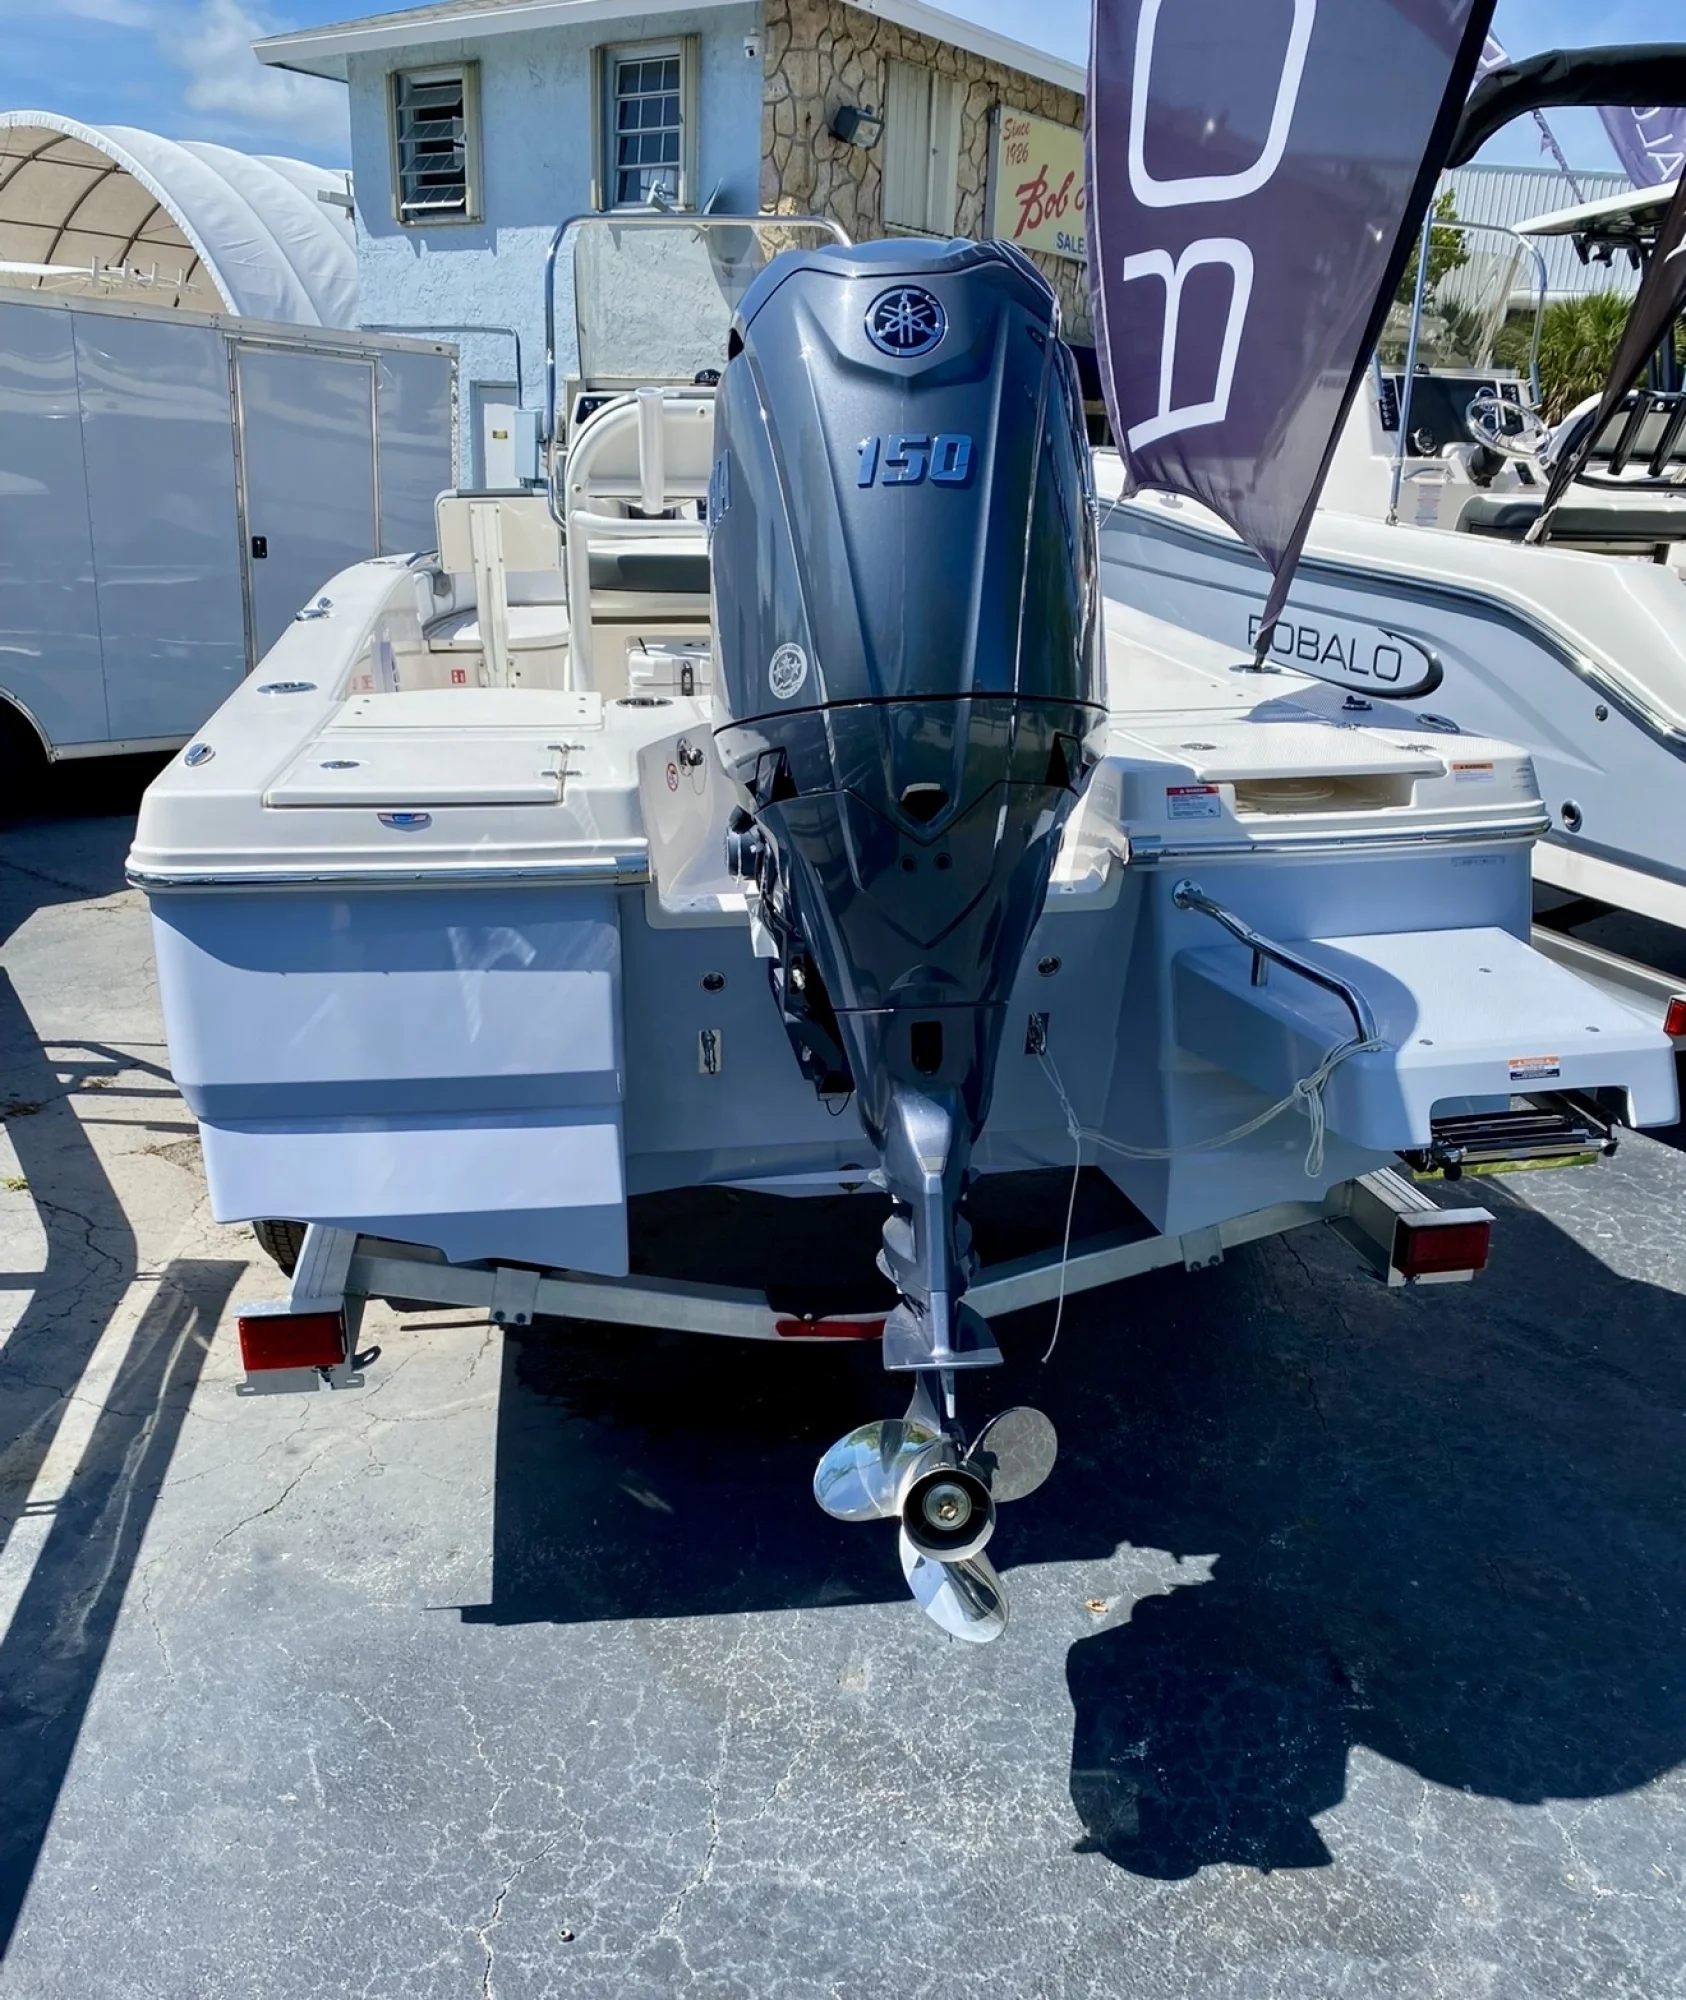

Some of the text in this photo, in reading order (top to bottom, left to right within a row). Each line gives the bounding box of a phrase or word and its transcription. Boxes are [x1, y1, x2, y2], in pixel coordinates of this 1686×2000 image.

[1013, 163, 1075, 239] Bob
[1056, 231, 1088, 255] SALE
[856, 432, 977, 489] 150
